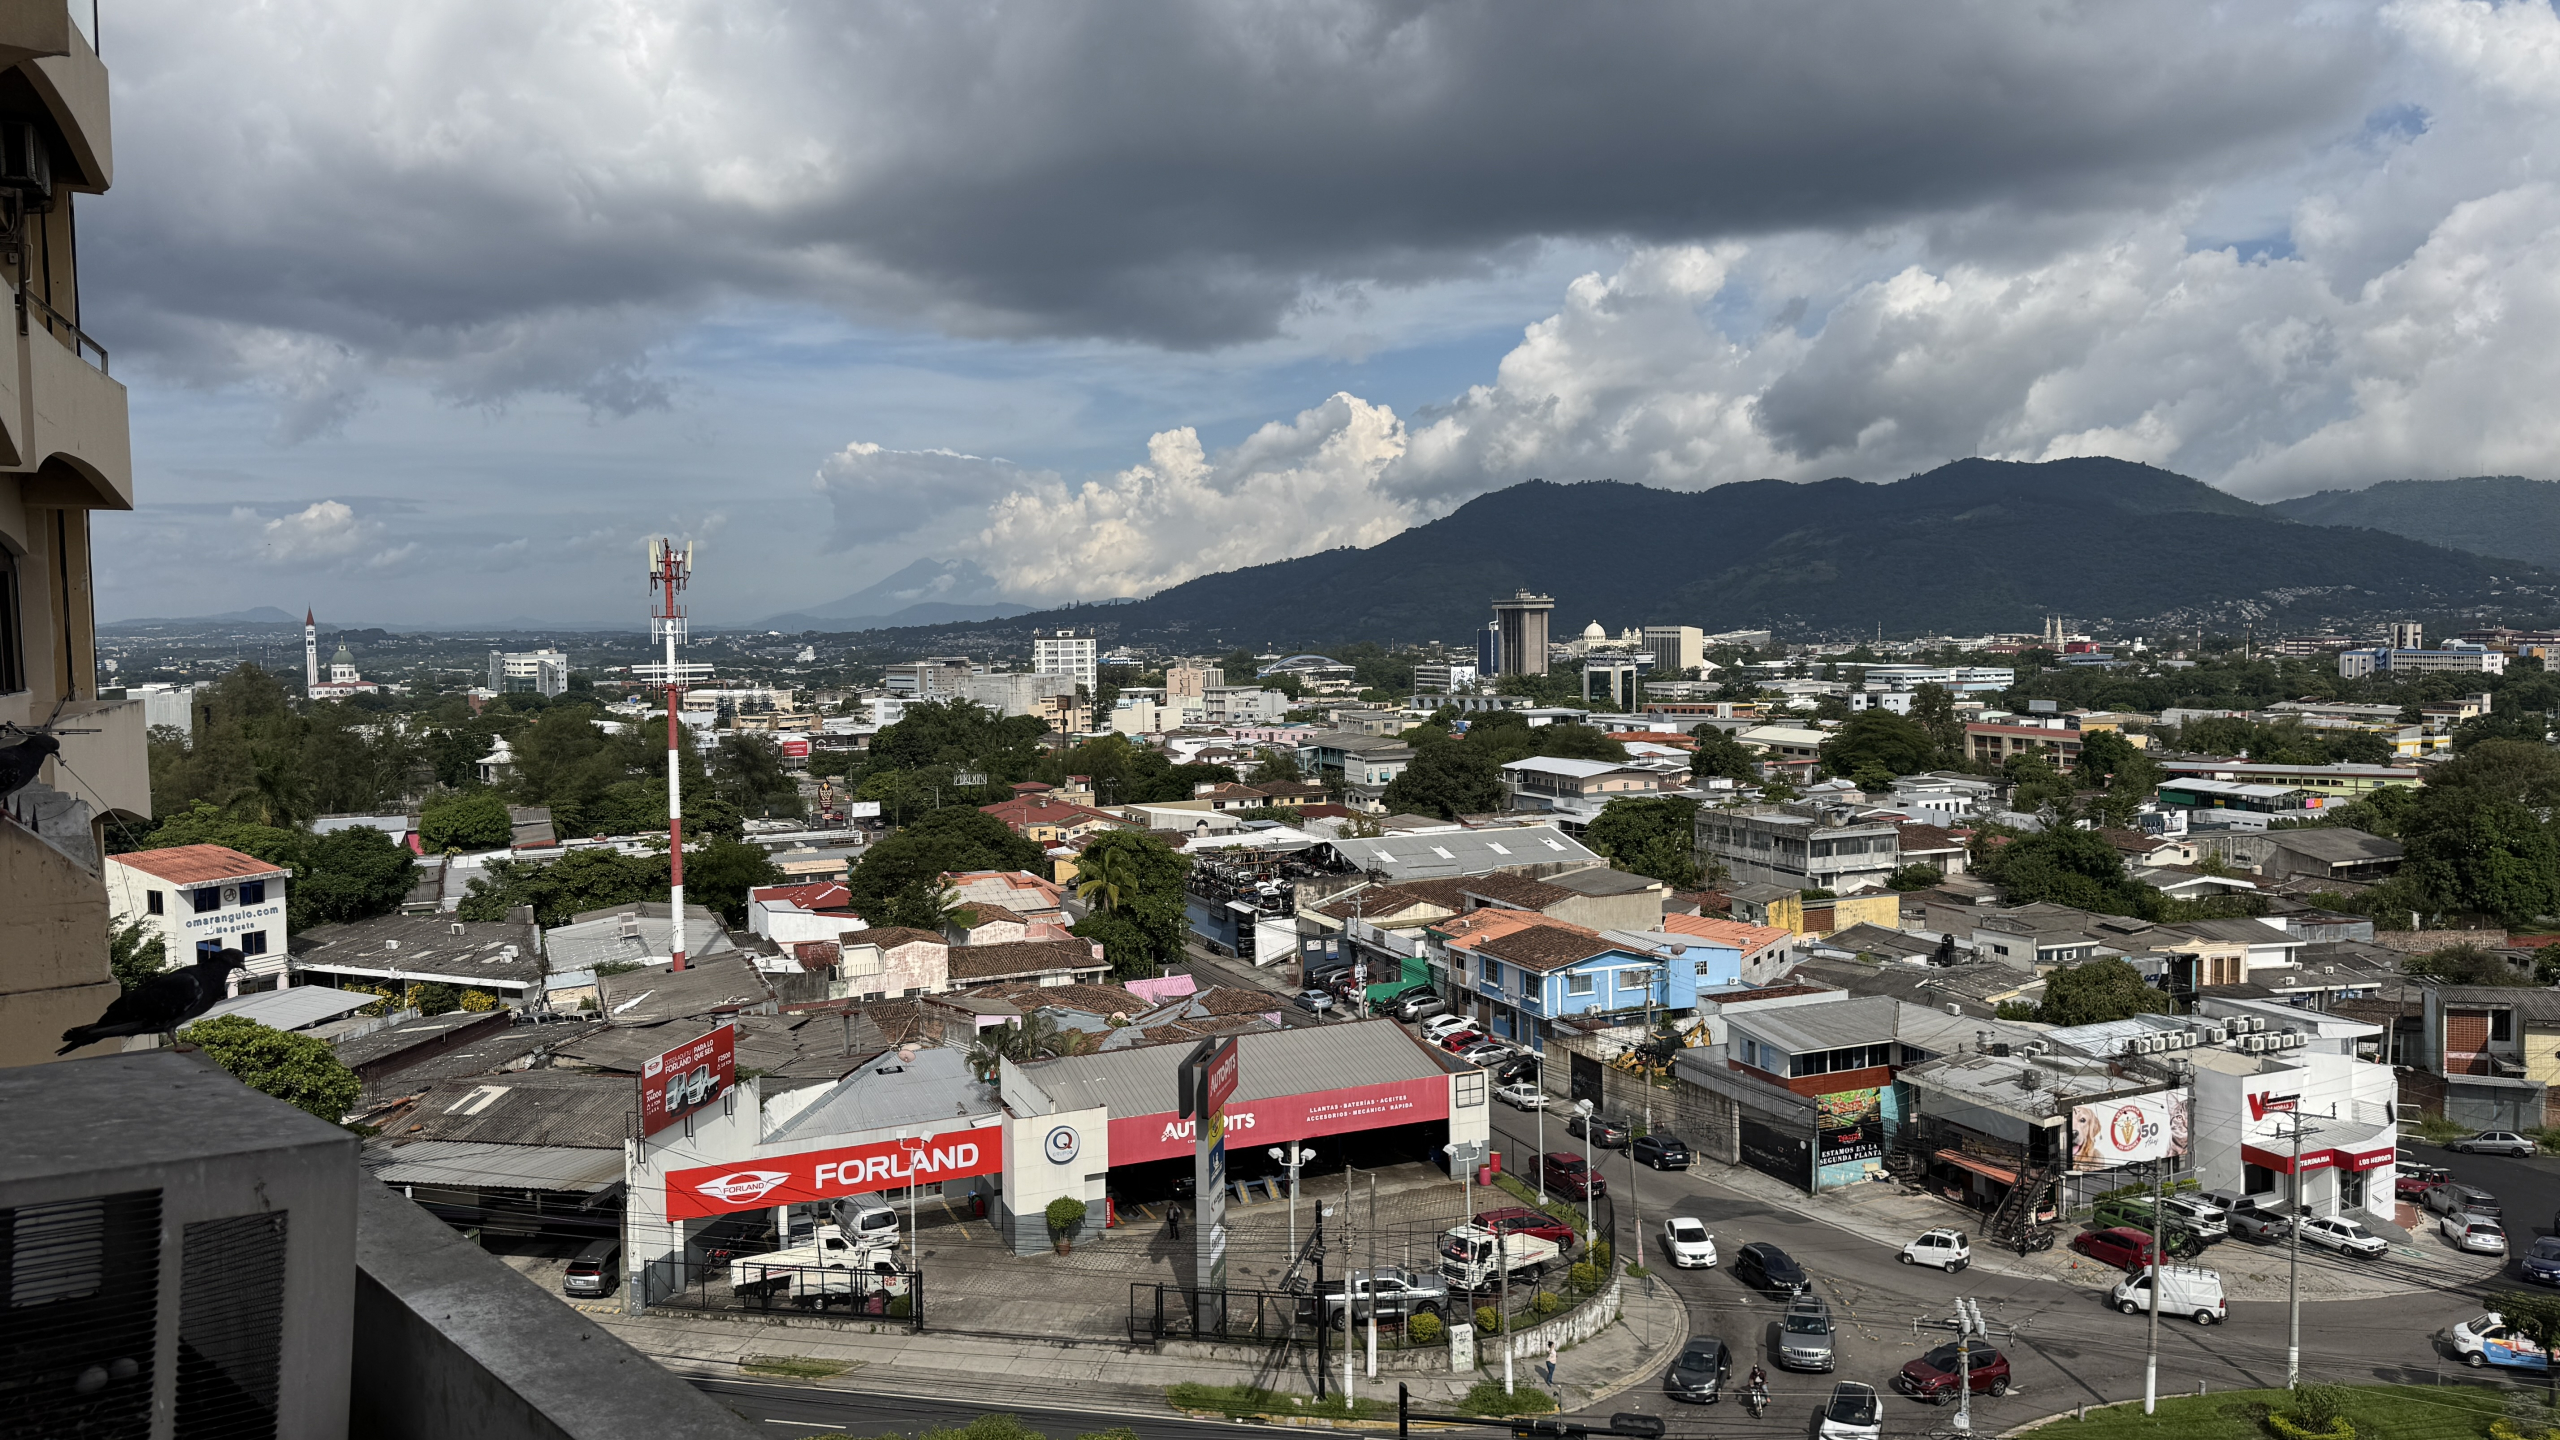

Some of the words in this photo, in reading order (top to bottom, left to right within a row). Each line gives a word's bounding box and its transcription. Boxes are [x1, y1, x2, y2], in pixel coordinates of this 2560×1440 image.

[186, 906, 278, 928] omarangulo.com
[230, 922, 255, 933] gusta
[693, 1042, 707, 1054] PARA
[706, 1039, 714, 1047] LO
[693, 1051, 705, 1061] QUE
[704, 1047, 714, 1057] SEA
[665, 1056, 692, 1075] FORLAND
[1306, 1112, 1348, 1122] ACCESORIOS
[1352, 1106, 1386, 1116] MECÁNICA
[1390, 1102, 1413, 1111] RÁPIDA
[1309, 1104, 1338, 1113] LLANTAS
[1343, 1099, 1375, 1108] BATERÍAS
[1380, 1095, 1407, 1103] ACEITES
[1161, 1112, 1255, 1142] AUTITS
[2141, 1122, 2159, 1138] 50
[1819, 1154, 1852, 1166] SEGUNDA
[1854, 1150, 1882, 1159] PLANTA
[1821, 1147, 1854, 1158] ESTAMOS
[1856, 1144, 1866, 1152] EN
[815, 1143, 979, 1189] FORLAND
[2293, 1155, 2330, 1169] TERINARIA
[723, 1182, 765, 1195] FORLAND
